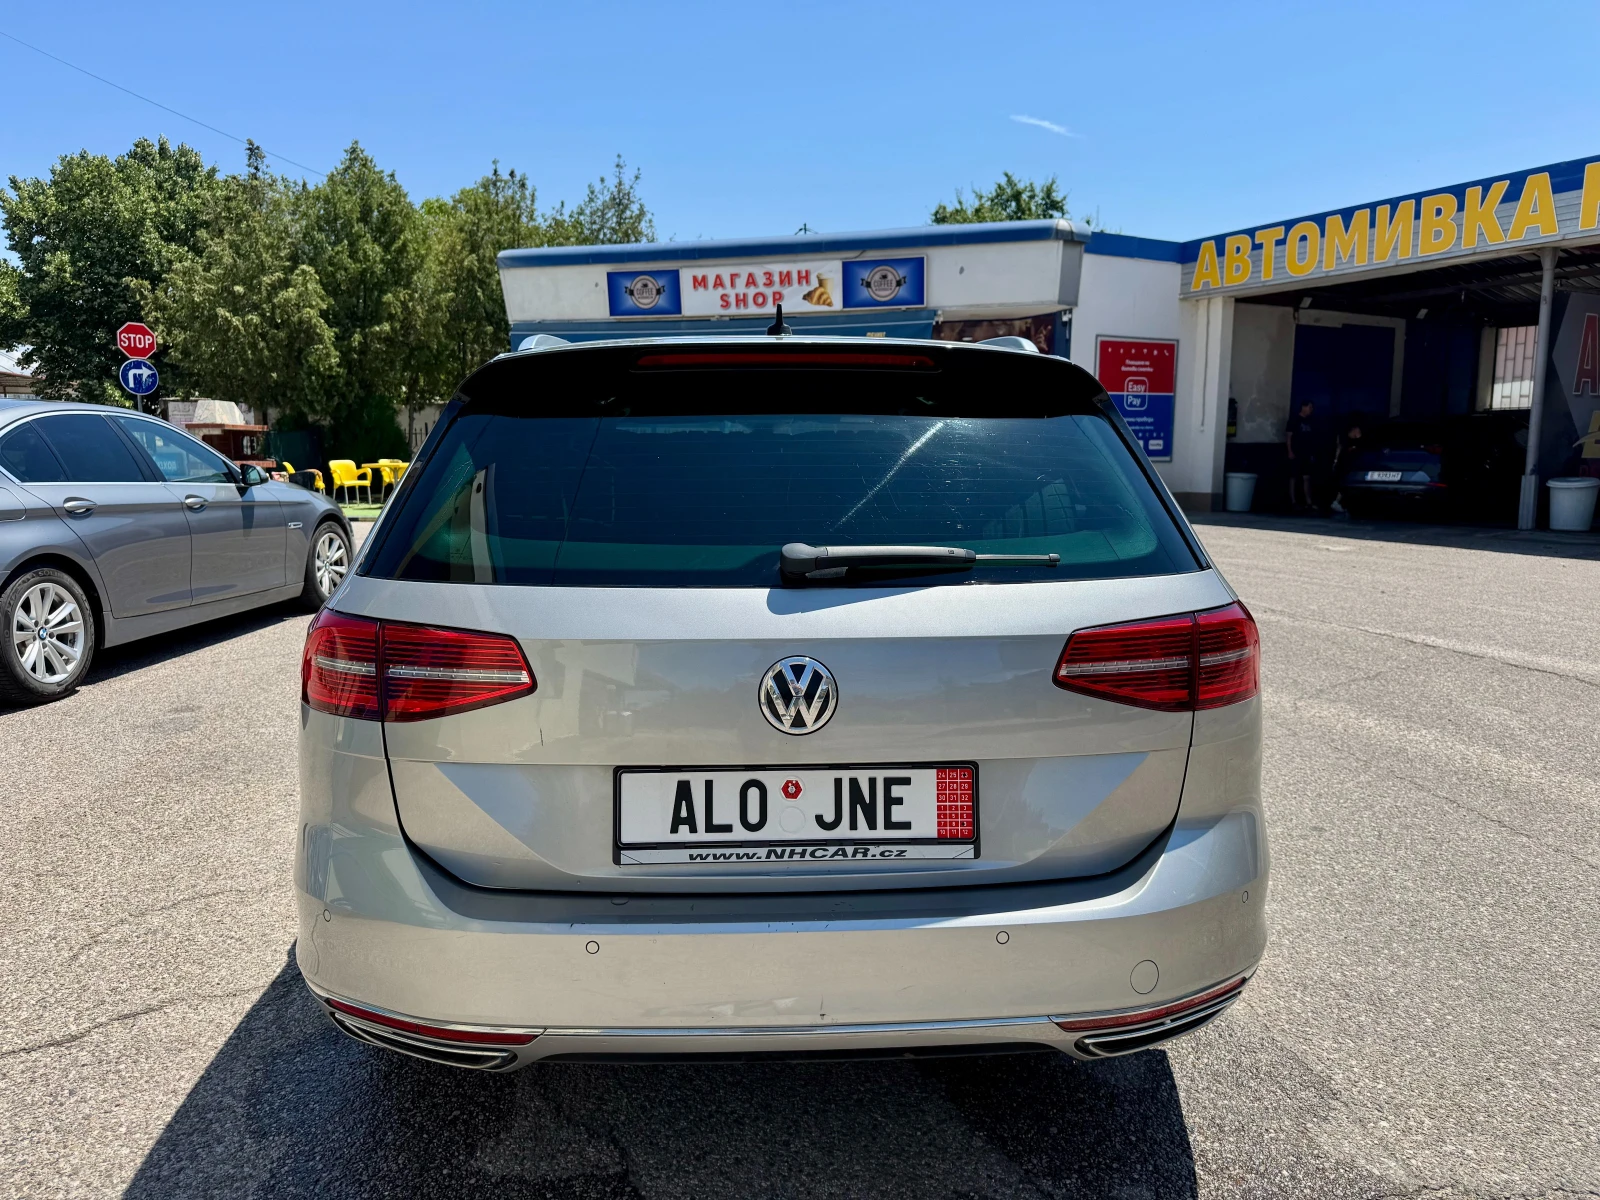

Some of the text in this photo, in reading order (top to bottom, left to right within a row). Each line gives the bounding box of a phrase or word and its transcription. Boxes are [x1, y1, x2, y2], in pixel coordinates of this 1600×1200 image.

[1190, 172, 1559, 291] АВТОМИВКА
[692, 269, 811, 290] МАГАЗИН
[720, 291, 783, 309] SHOP
[121, 333, 153, 348] STOP
[1128, 382, 1146, 394] Easy
[1127, 395, 1141, 407] Pay
[670, 777, 912, 834] ALO JNE
[688, 847, 908, 861] www.NHCAR.cz
